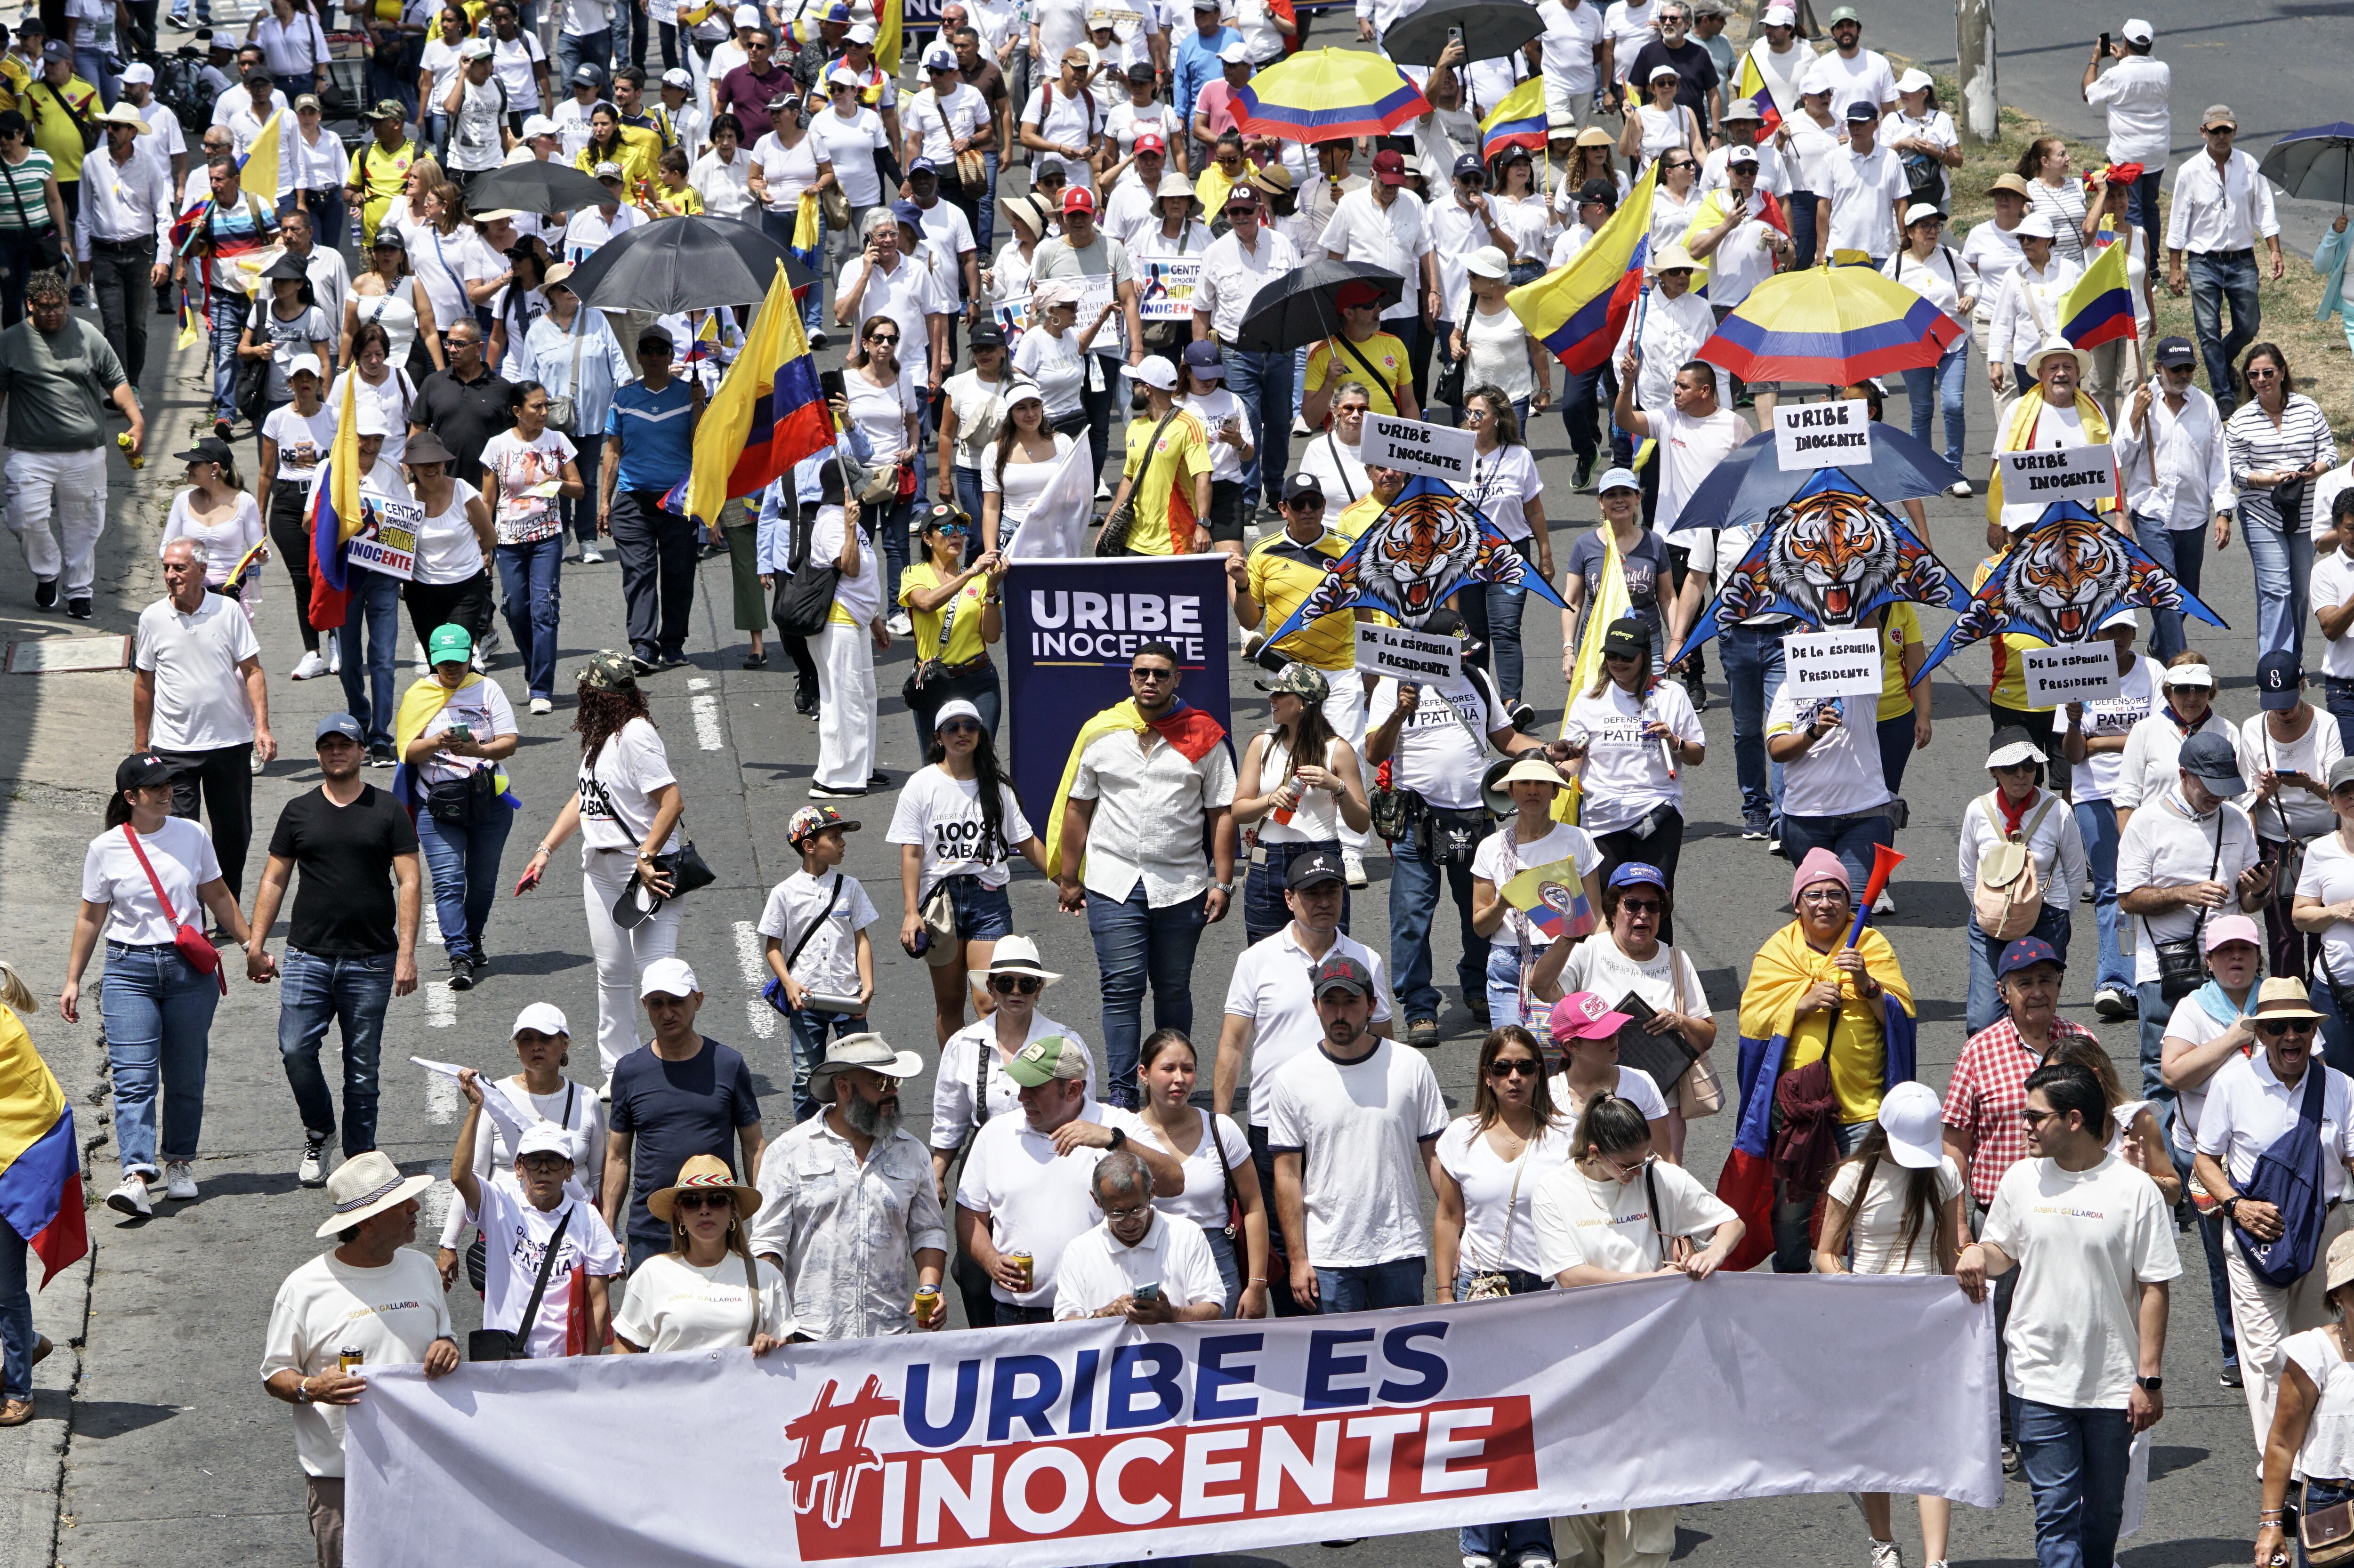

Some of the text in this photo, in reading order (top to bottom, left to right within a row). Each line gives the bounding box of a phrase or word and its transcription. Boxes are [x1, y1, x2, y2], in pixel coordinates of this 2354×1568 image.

[1786, 406, 1849, 428] URIBE
[1377, 423, 1431, 444] URIBE
[1795, 432, 1867, 452] INOCENTE
[1387, 443, 1462, 471] INOCENTE
[2012, 453, 2068, 471] URIBE
[2029, 470, 2106, 491] INOCENTE
[385, 502, 423, 523] CENTRO
[379, 527, 416, 554] #URIBE
[1031, 590, 1202, 635] URIBE
[1362, 630, 1378, 643] DE
[1384, 634, 1398, 647] LA
[1792, 646, 1806, 659] DE
[1810, 645, 1823, 658] LA
[1378, 651, 1451, 677] PRESIDENTE
[2029, 658, 2044, 669] DE
[1799, 667, 1870, 682] PRESIDENTE
[2039, 676, 2108, 691] PRESIDENTE
[932, 812, 969, 821] LIBERTAD
[1449, 842, 1473, 850] adidas
[1322, 962, 1354, 980] LA
[1584, 996, 1600, 1011] Super
[1591, 1001, 1605, 1012] Dry
[2033, 1206, 2104, 1219] SOBRA GALLARDIA
[1575, 1219, 1602, 1227] SOBRA
[2250, 1247, 2266, 1265] FESA
[348, 1300, 420, 1320] SOBRA GALLARDIA
[1303, 1320, 1449, 1411] ES
[879, 1406, 1494, 1547] INOCENTE
